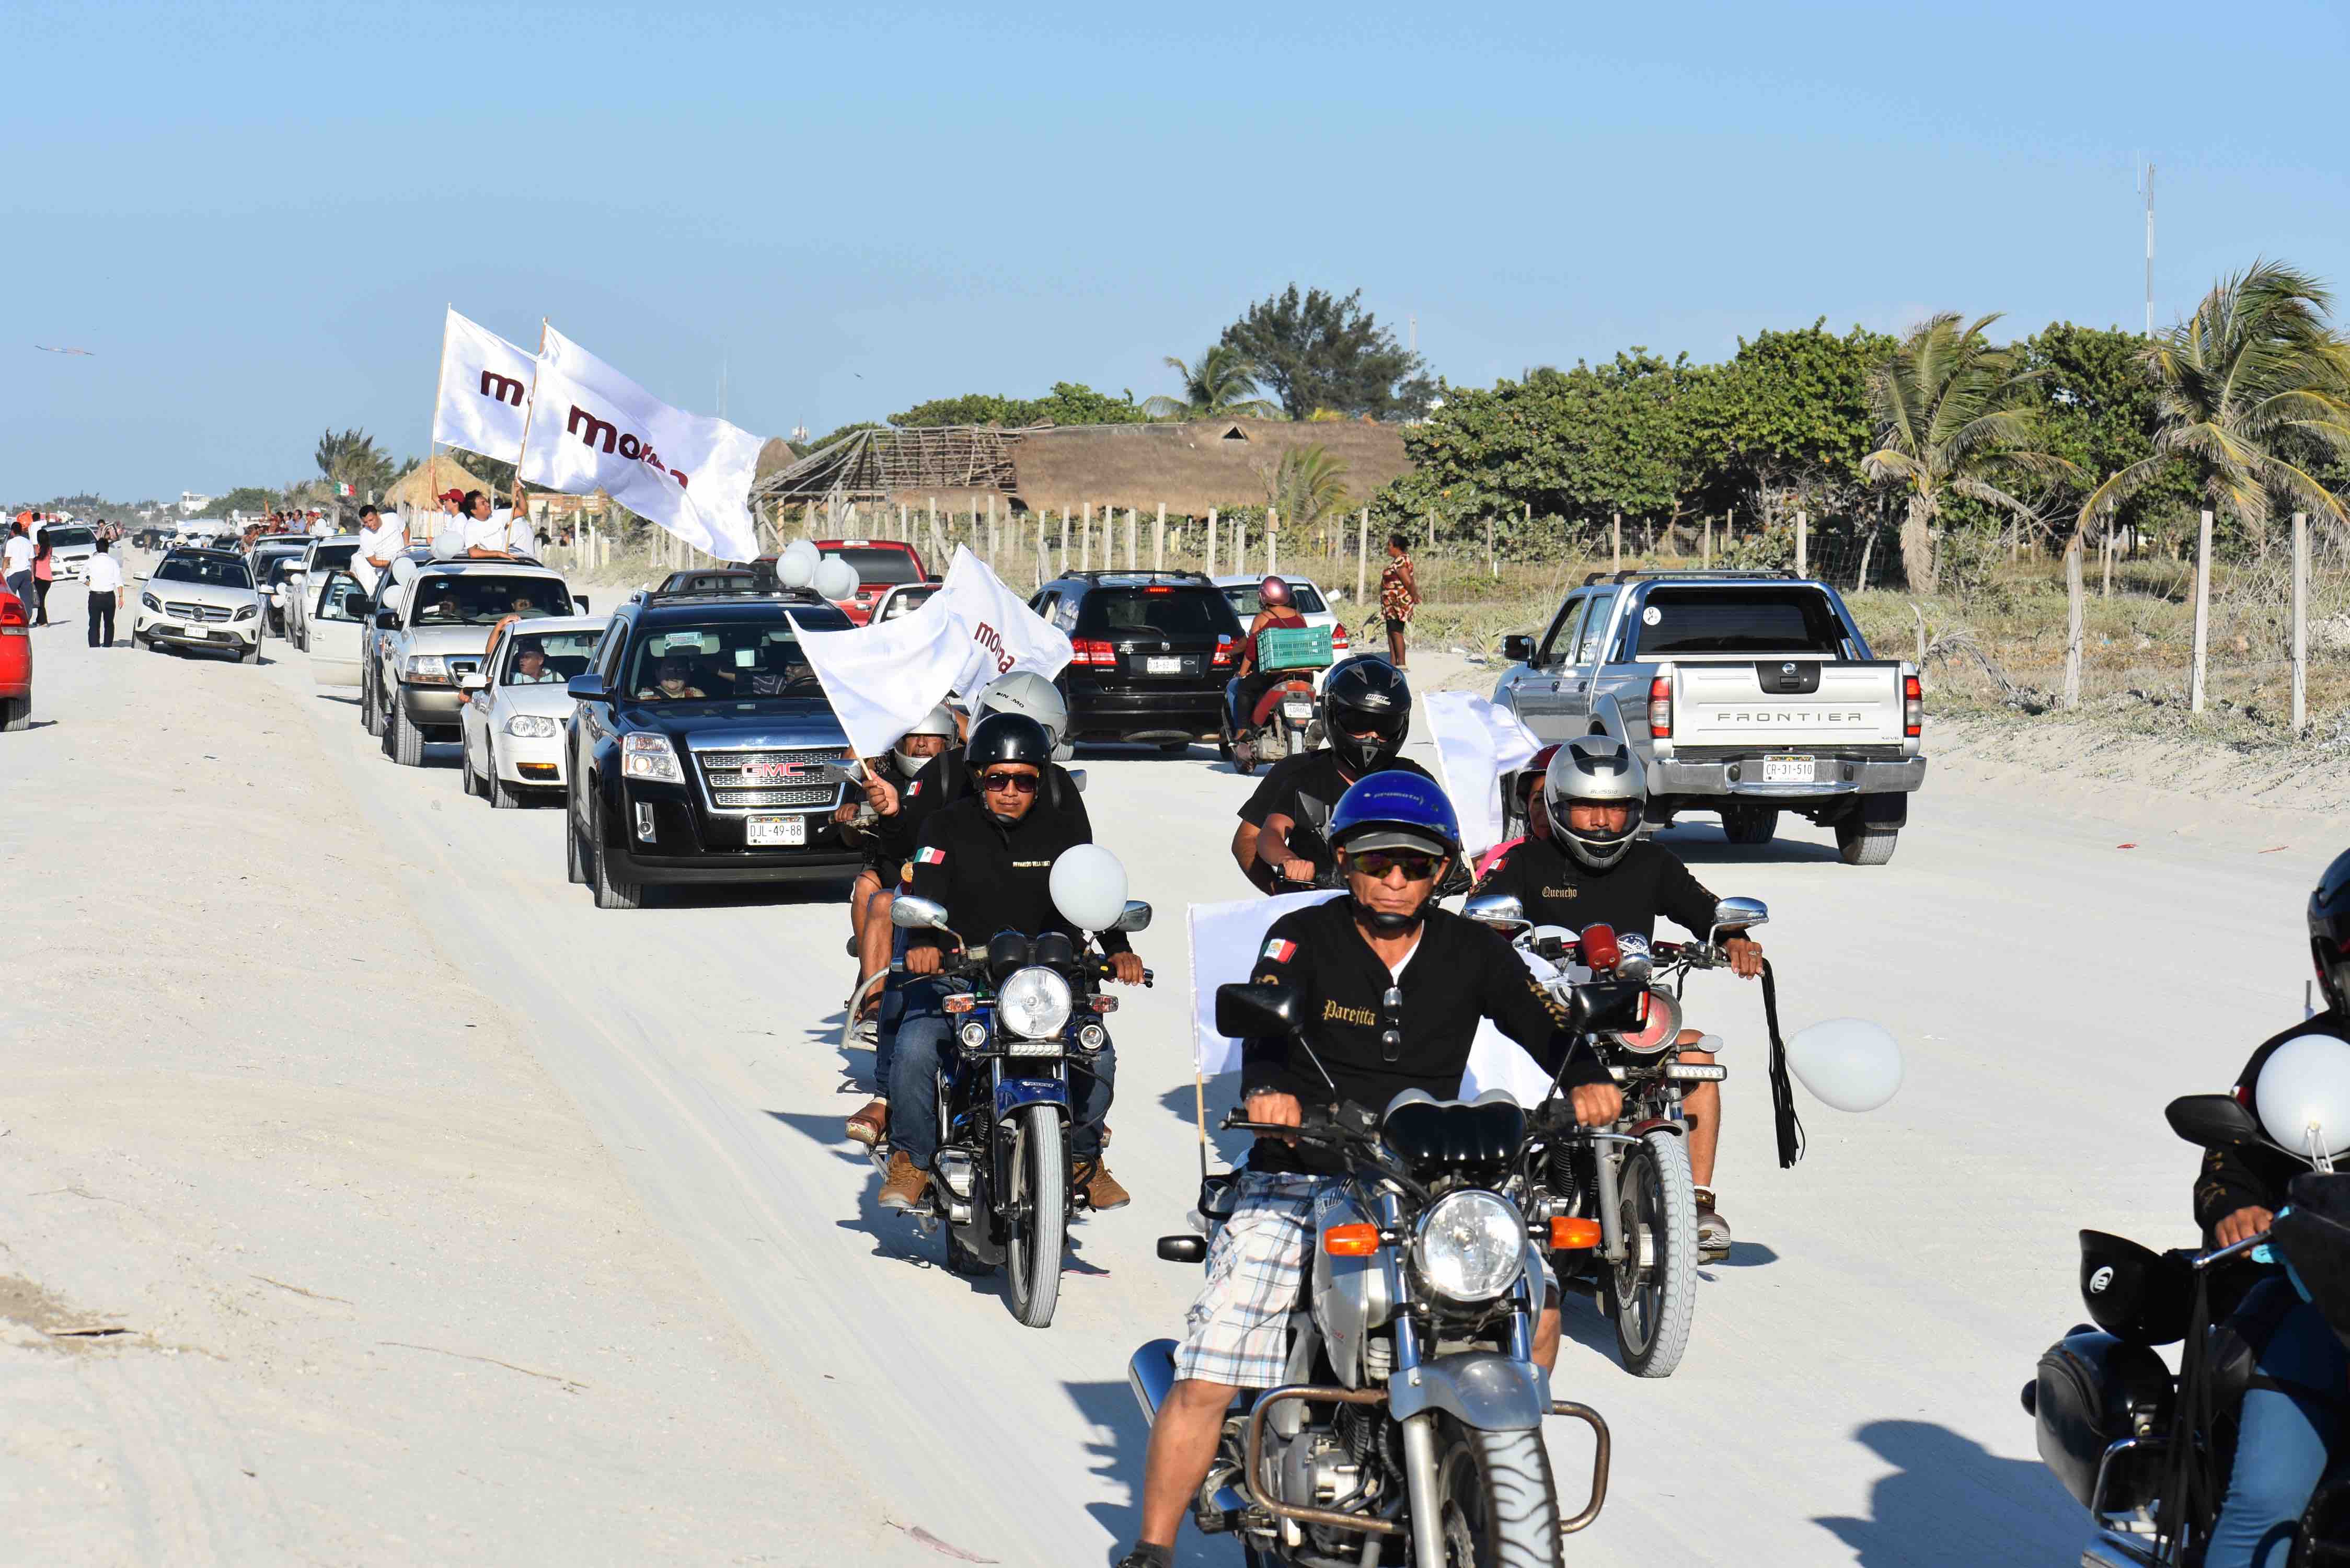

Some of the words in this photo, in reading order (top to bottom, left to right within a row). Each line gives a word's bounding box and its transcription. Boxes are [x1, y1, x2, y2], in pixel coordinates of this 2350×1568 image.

[996, 692, 1024, 708] DINMO
[742, 762, 805, 778] GMC
[1767, 764, 1812, 774] CR-31-510
[750, 825, 802, 837] DJL-49-88
[1542, 886, 1577, 899] Quencho
[1321, 999, 1376, 1027] Parejita
